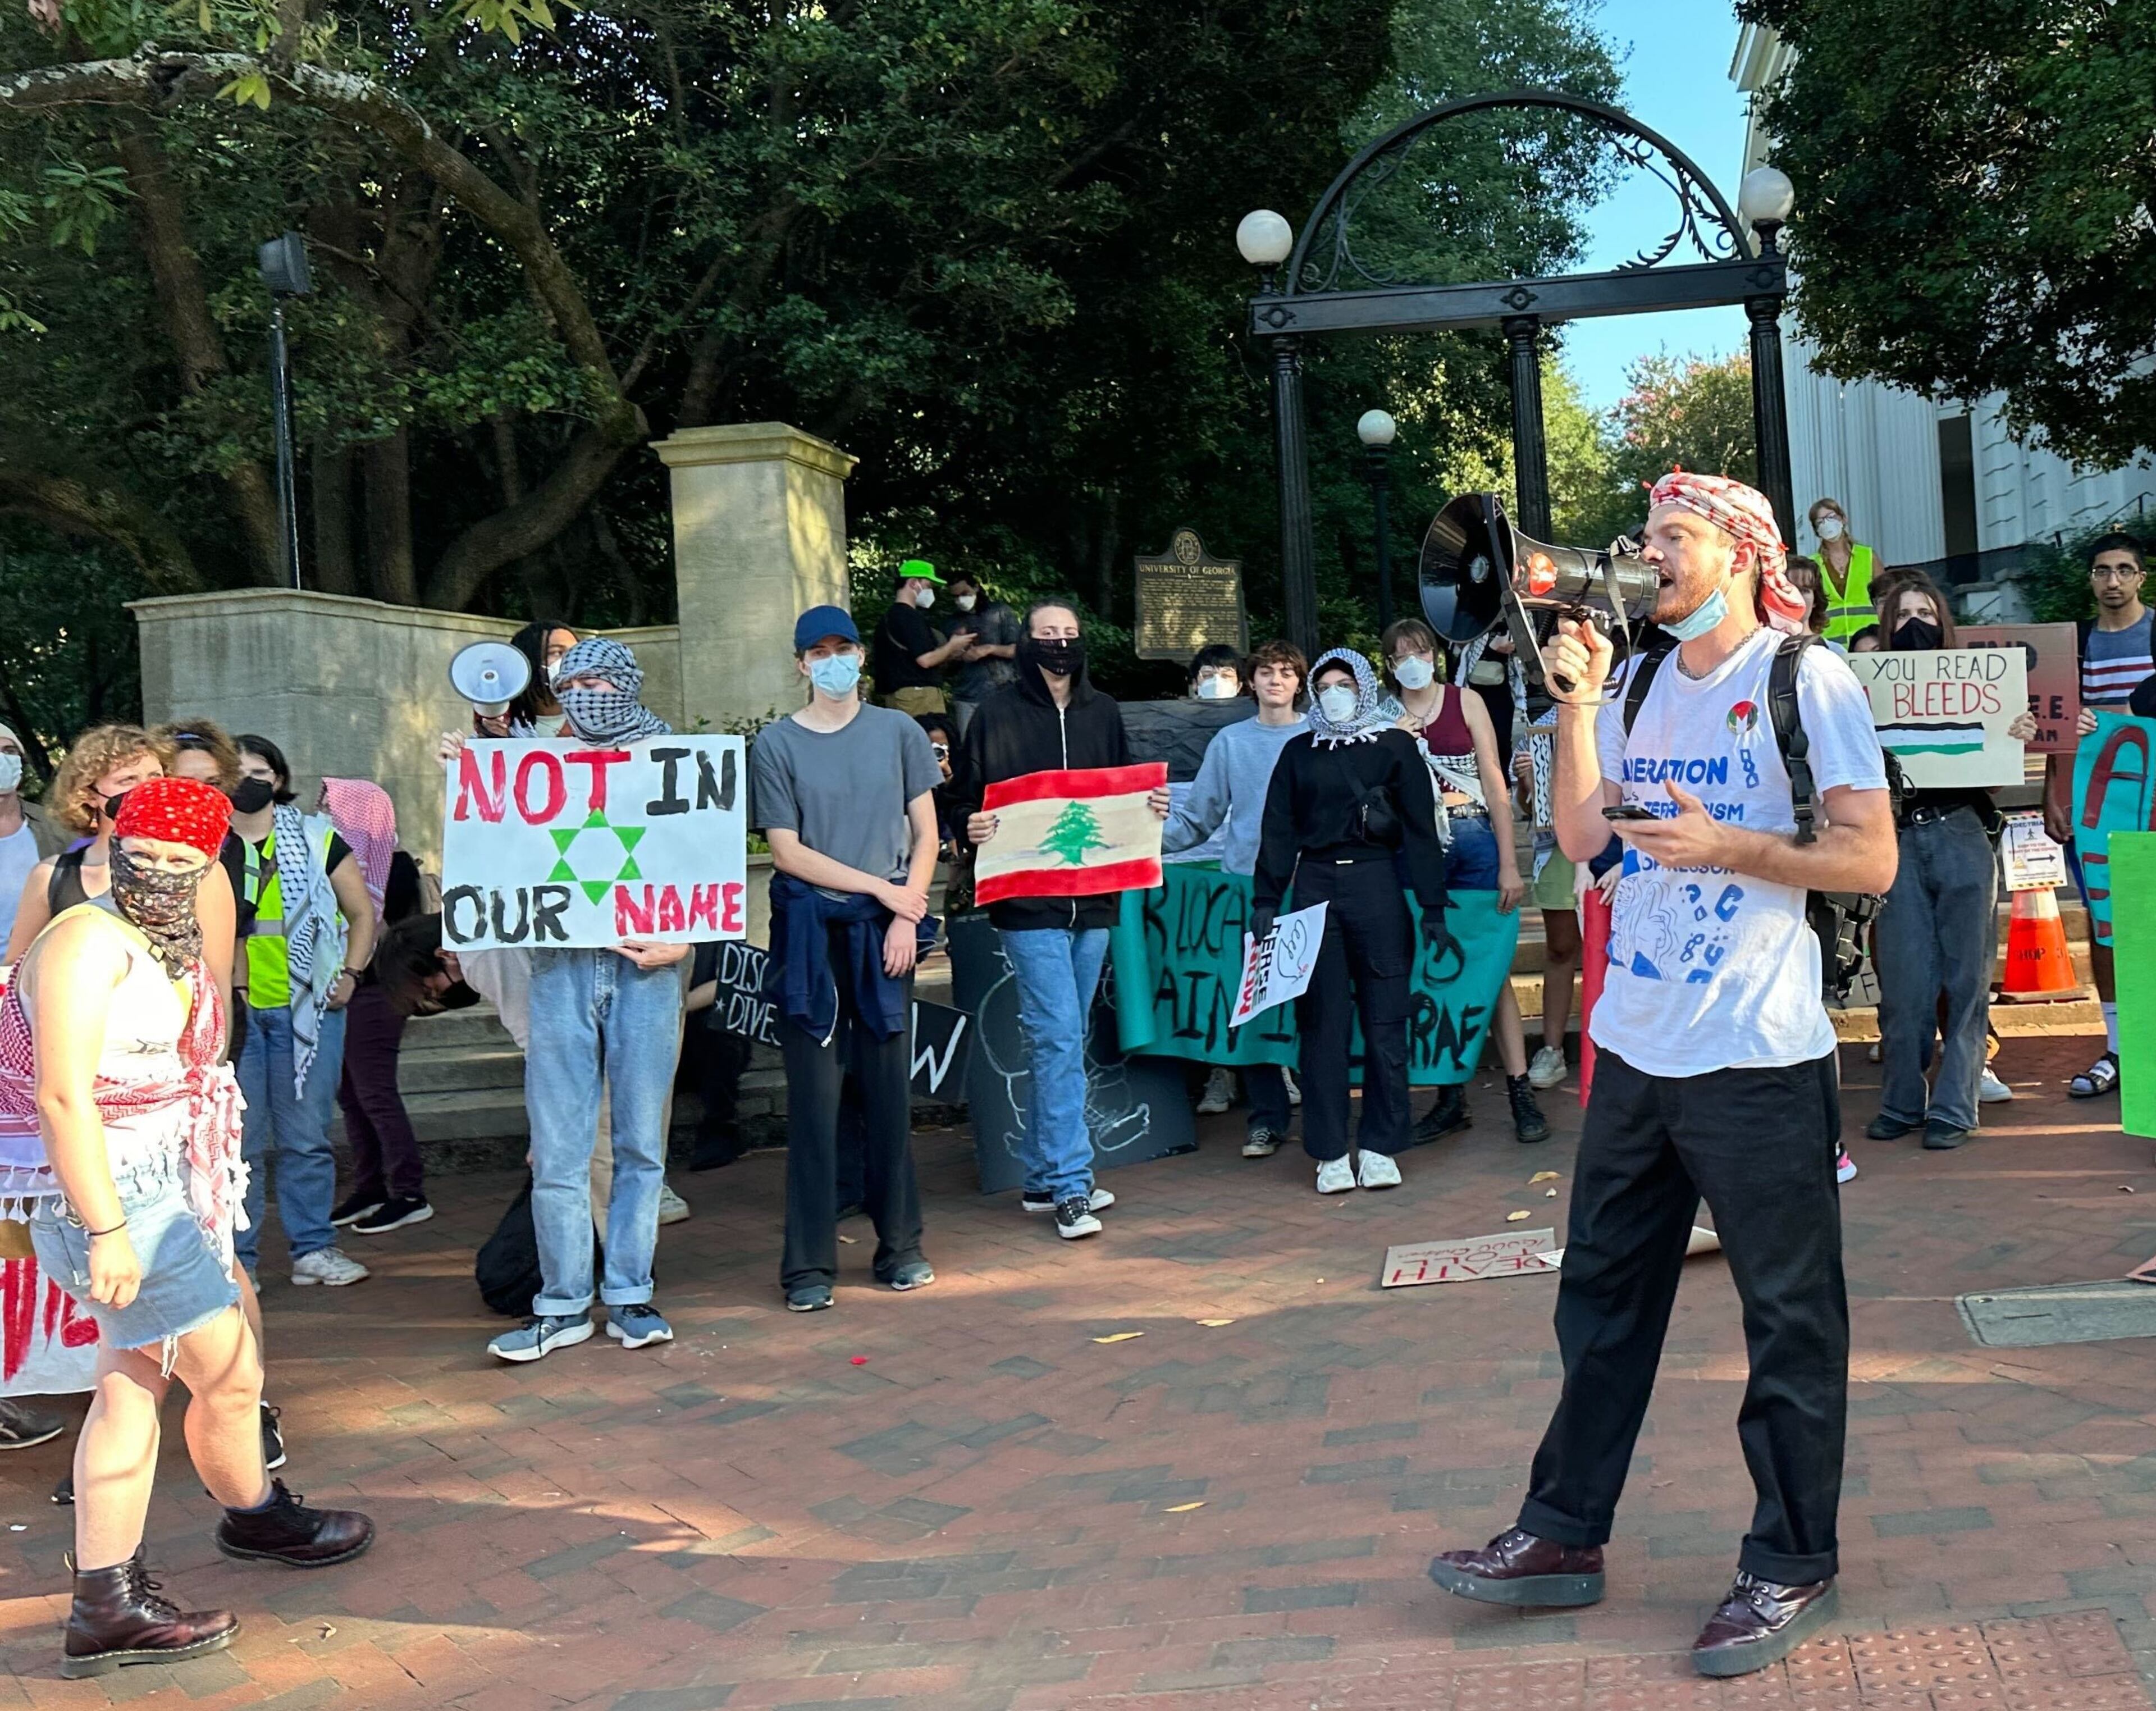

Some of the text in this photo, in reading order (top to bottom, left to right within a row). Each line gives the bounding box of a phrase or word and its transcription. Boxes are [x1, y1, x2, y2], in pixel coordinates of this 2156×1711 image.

[1140, 564, 1235, 574] UNIVERSITY OF GEORGIA
[1871, 658, 1915, 681] YOU
[1936, 654, 2007, 681] READ
[1894, 682, 2001, 719] BLEEDS
[454, 747, 737, 825] NOT IN
[1644, 801, 1744, 822] TERRISM
[441, 882, 744, 945] OUR NAME
